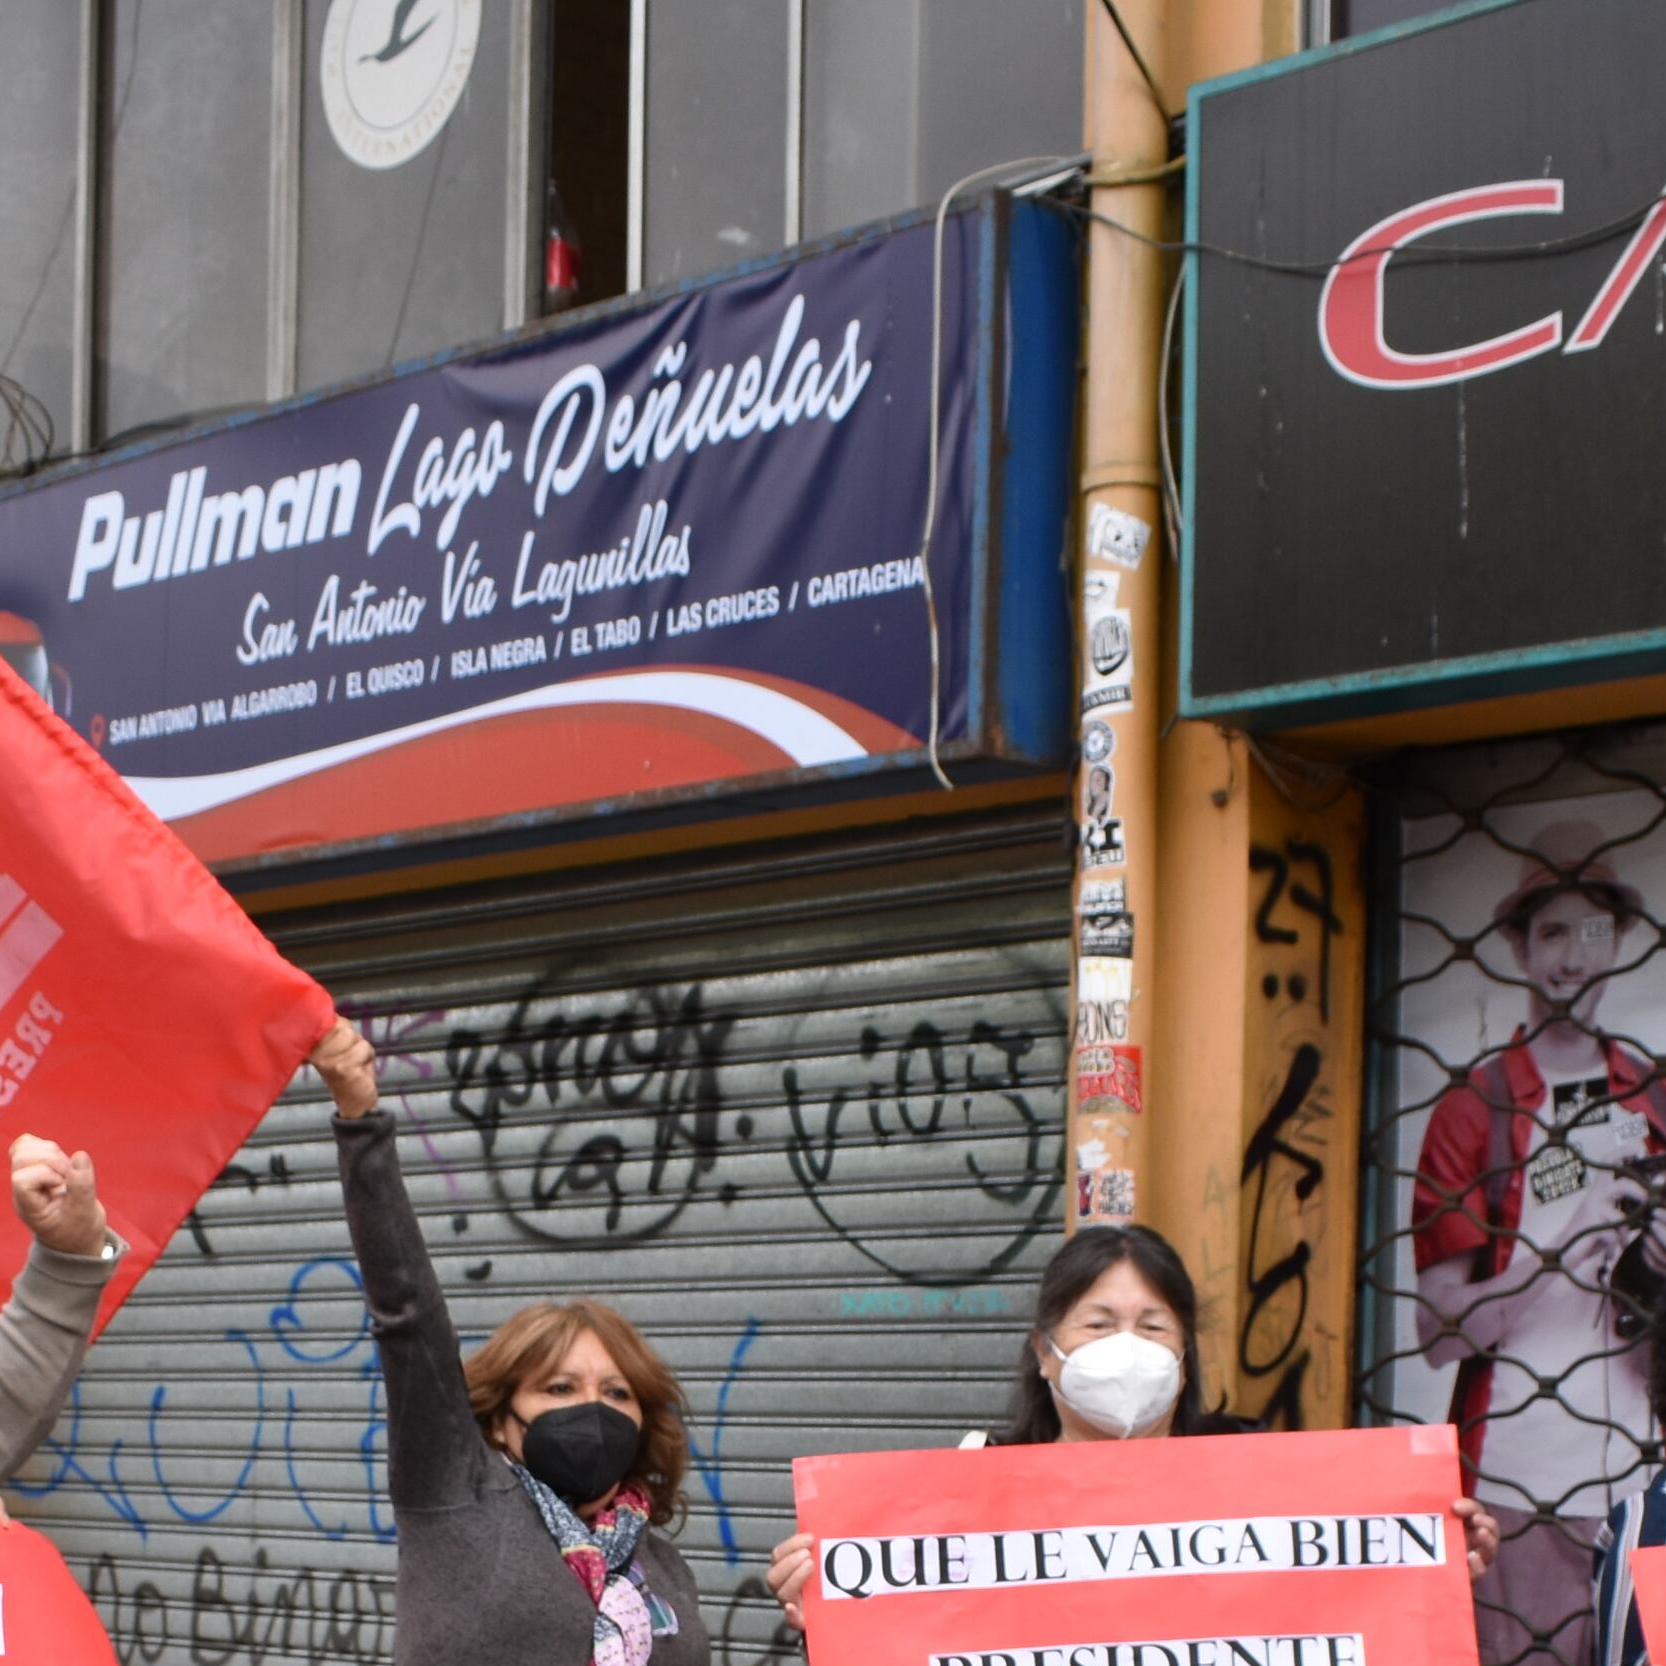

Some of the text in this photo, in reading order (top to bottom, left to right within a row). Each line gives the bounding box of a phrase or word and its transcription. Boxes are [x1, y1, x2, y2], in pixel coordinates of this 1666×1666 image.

[68, 294, 872, 603] Pullman Lago Peñuelas
[109, 717, 137, 746] SAN
[137, 705, 197, 740] ANTONIO
[202, 699, 225, 725] VIA
[232, 680, 318, 721] ALGARROBO
[346, 672, 364, 698] EL
[368, 658, 424, 695] QUISCO
[452, 642, 487, 677] ISLA
[490, 631, 547, 673] NEGRA
[571, 628, 591, 656] EL
[595, 615, 641, 651] TABO
[667, 602, 702, 637] LAS
[706, 586, 780, 629] CRUCES
[807, 555, 925, 608] CARTAGENA
[236, 592, 297, 665] San
[307, 574, 426, 653] Antonio
[511, 499, 691, 623] Lagunillas
[823, 1514, 1441, 1599] QUE LE VAIGA BIEN
